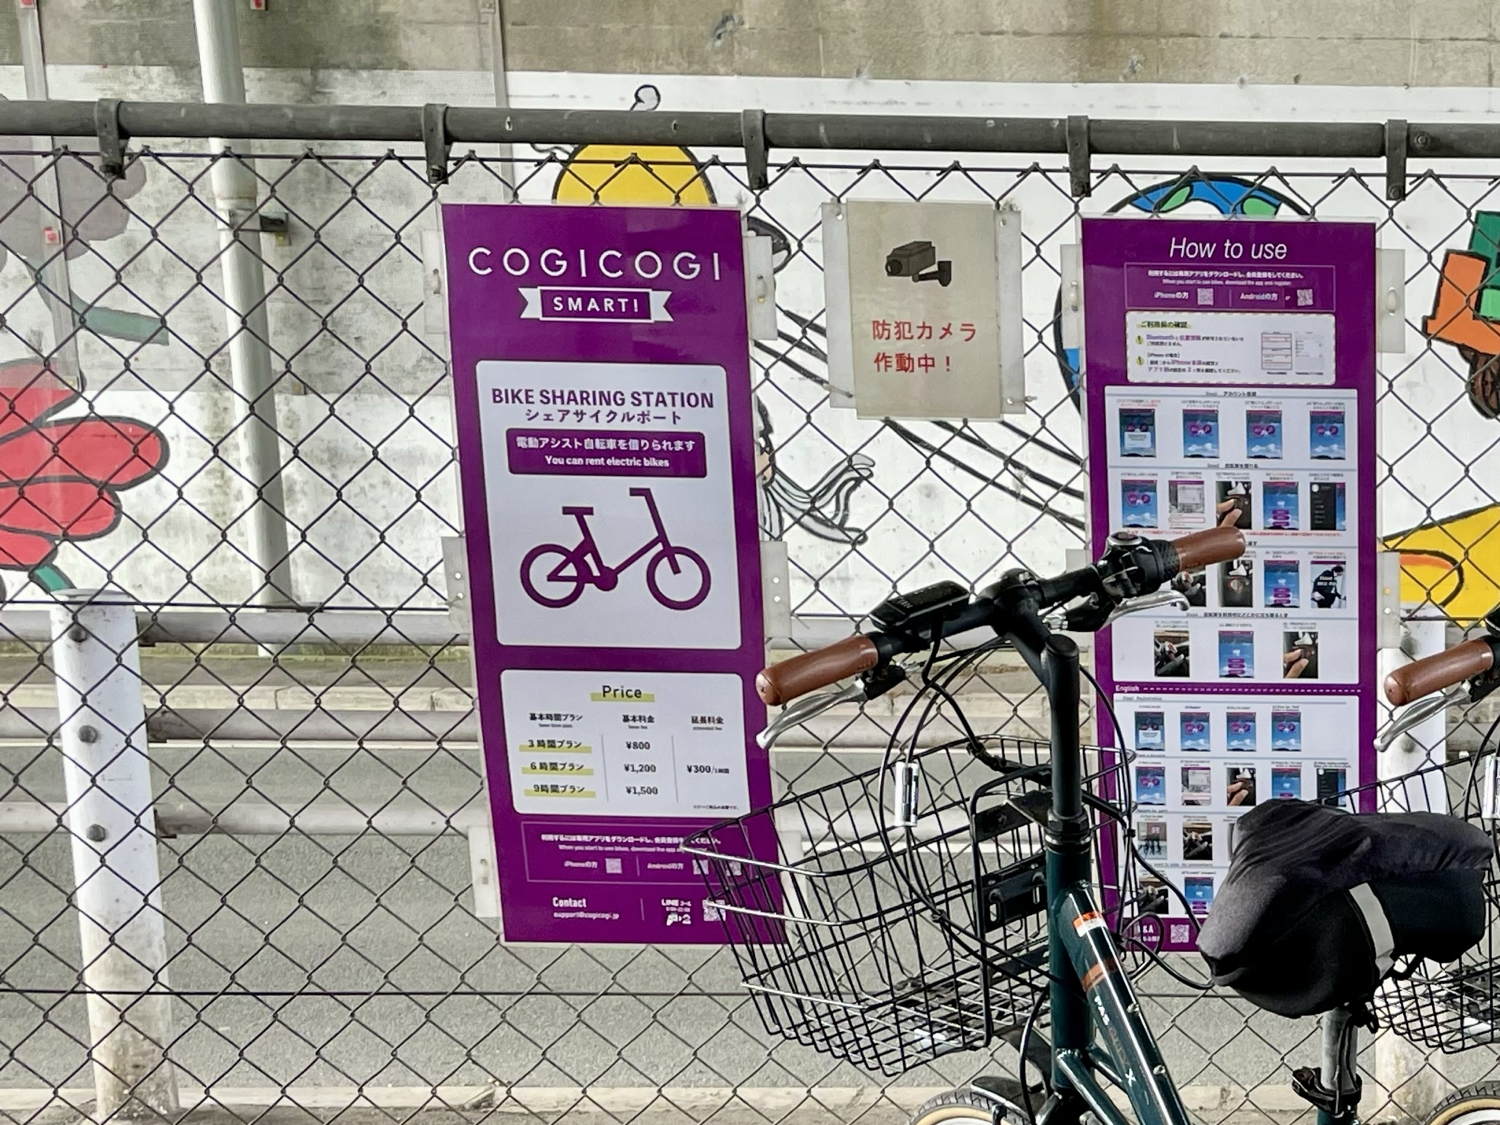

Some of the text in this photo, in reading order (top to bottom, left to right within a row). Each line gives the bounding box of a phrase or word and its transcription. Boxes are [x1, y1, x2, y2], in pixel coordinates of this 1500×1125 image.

[1169, 237, 1288, 260] How to use
[468, 247, 721, 281] COGICOGI
[553, 296, 639, 313] SMART!
[872, 319, 977, 342] 防犯カメラ
[492, 388, 715, 408] BIKE SHARING STATION
[525, 409, 682, 426] シェアサイクルポート
[516, 436, 696, 452] 電動アシスト自転車を借りられます
[545, 455, 670, 468] You can rent electric bikes
[601, 685, 643, 699] Price
[1115, 684, 1140, 693] English
[622, 714, 655, 723] 基本料金
[625, 741, 651, 750] ¥800
[623, 763, 657, 774] ¥1,200
[625, 786, 659, 796] ¥1,500
[552, 896, 587, 908] Contact
[661, 898, 680, 907] LINE
